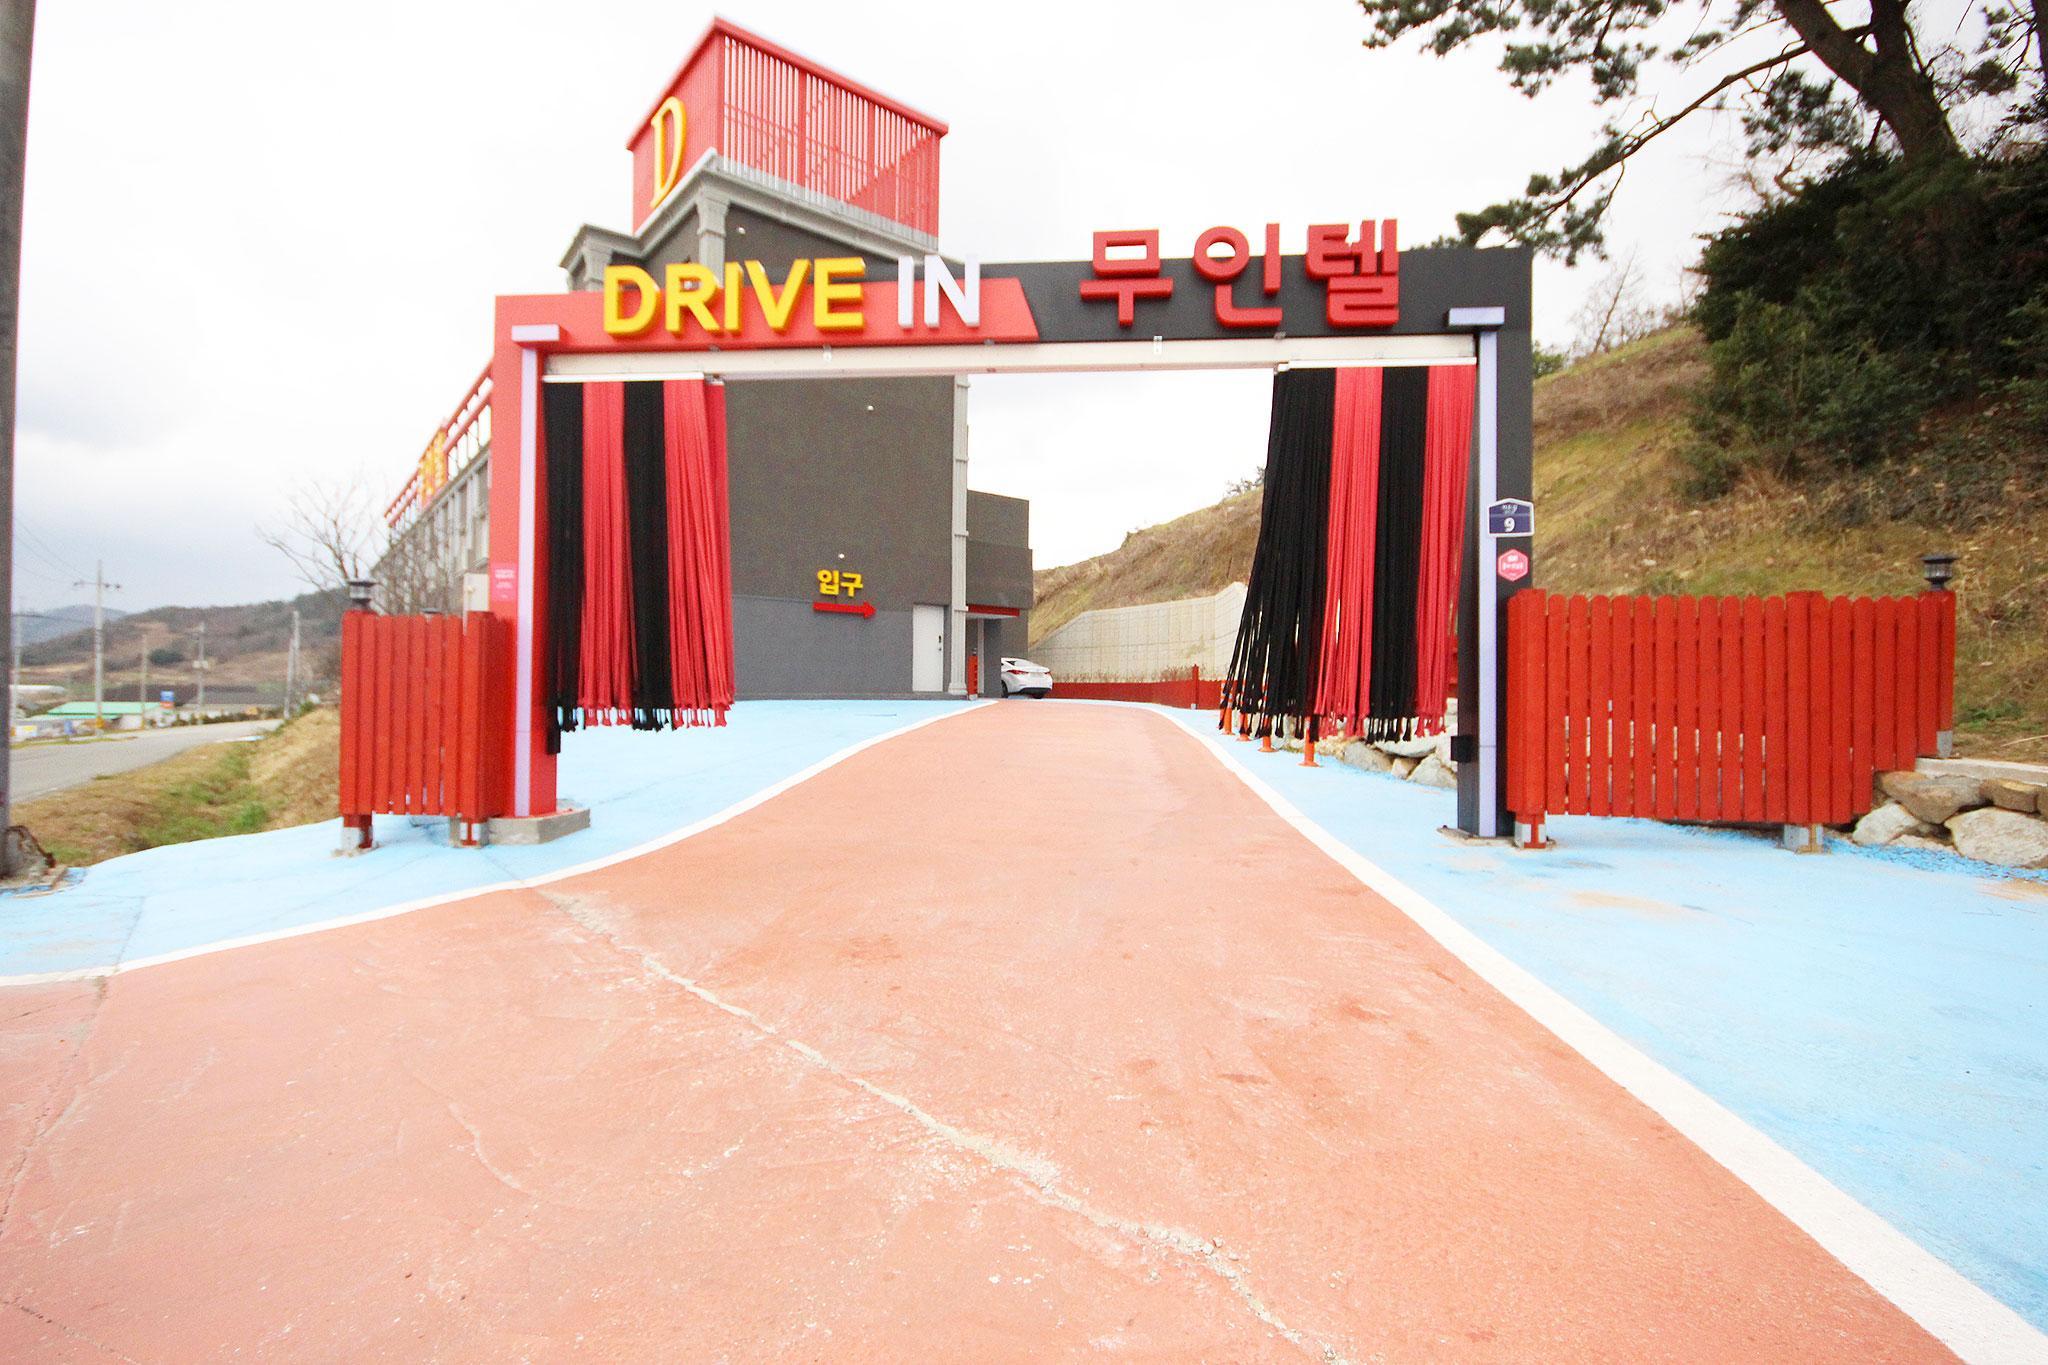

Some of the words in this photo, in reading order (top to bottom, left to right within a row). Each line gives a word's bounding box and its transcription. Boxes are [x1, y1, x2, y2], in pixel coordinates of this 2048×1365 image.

[604, 257, 865, 336] DRIVE
[897, 254, 981, 328] IN
[1080, 219, 1400, 327] 무인텔
[1503, 517, 1515, 532] 9
[817, 569, 863, 597] 입구
